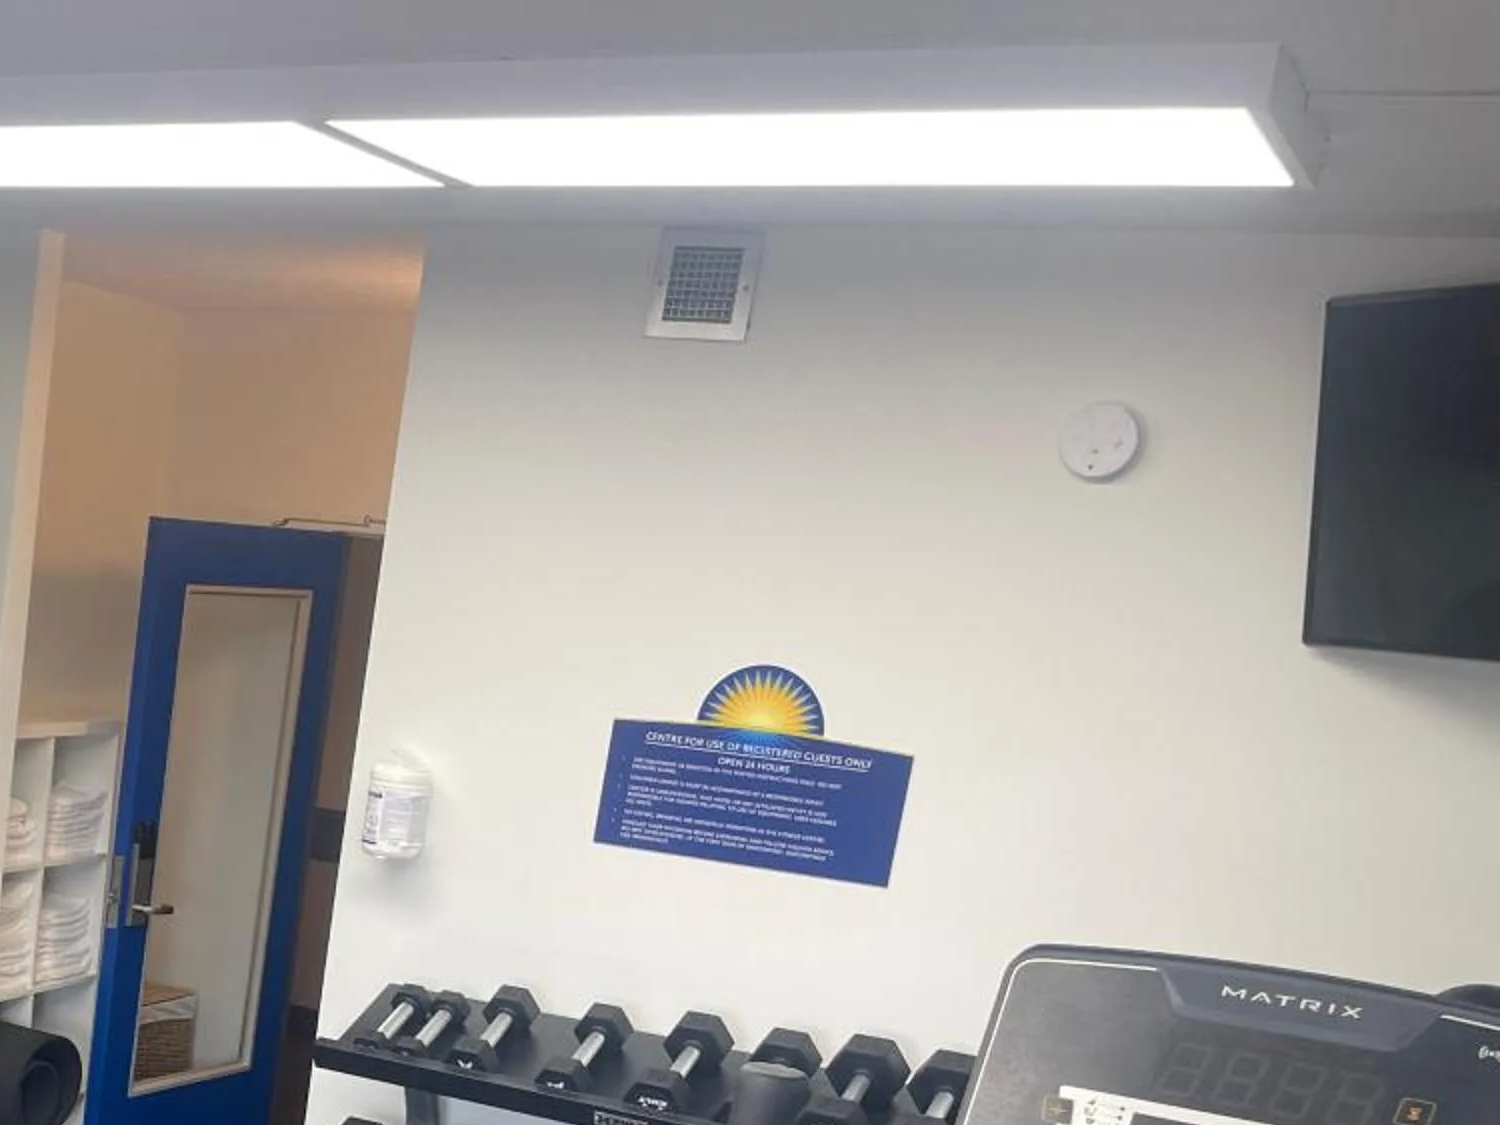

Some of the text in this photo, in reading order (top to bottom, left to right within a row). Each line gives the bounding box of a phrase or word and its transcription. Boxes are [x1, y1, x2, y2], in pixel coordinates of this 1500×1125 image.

[717, 756, 742, 768] OPEN
[757, 761, 790, 774] HOURS
[844, 756, 873, 769] ONLY
[1220, 985, 1364, 1019] MATRIX
